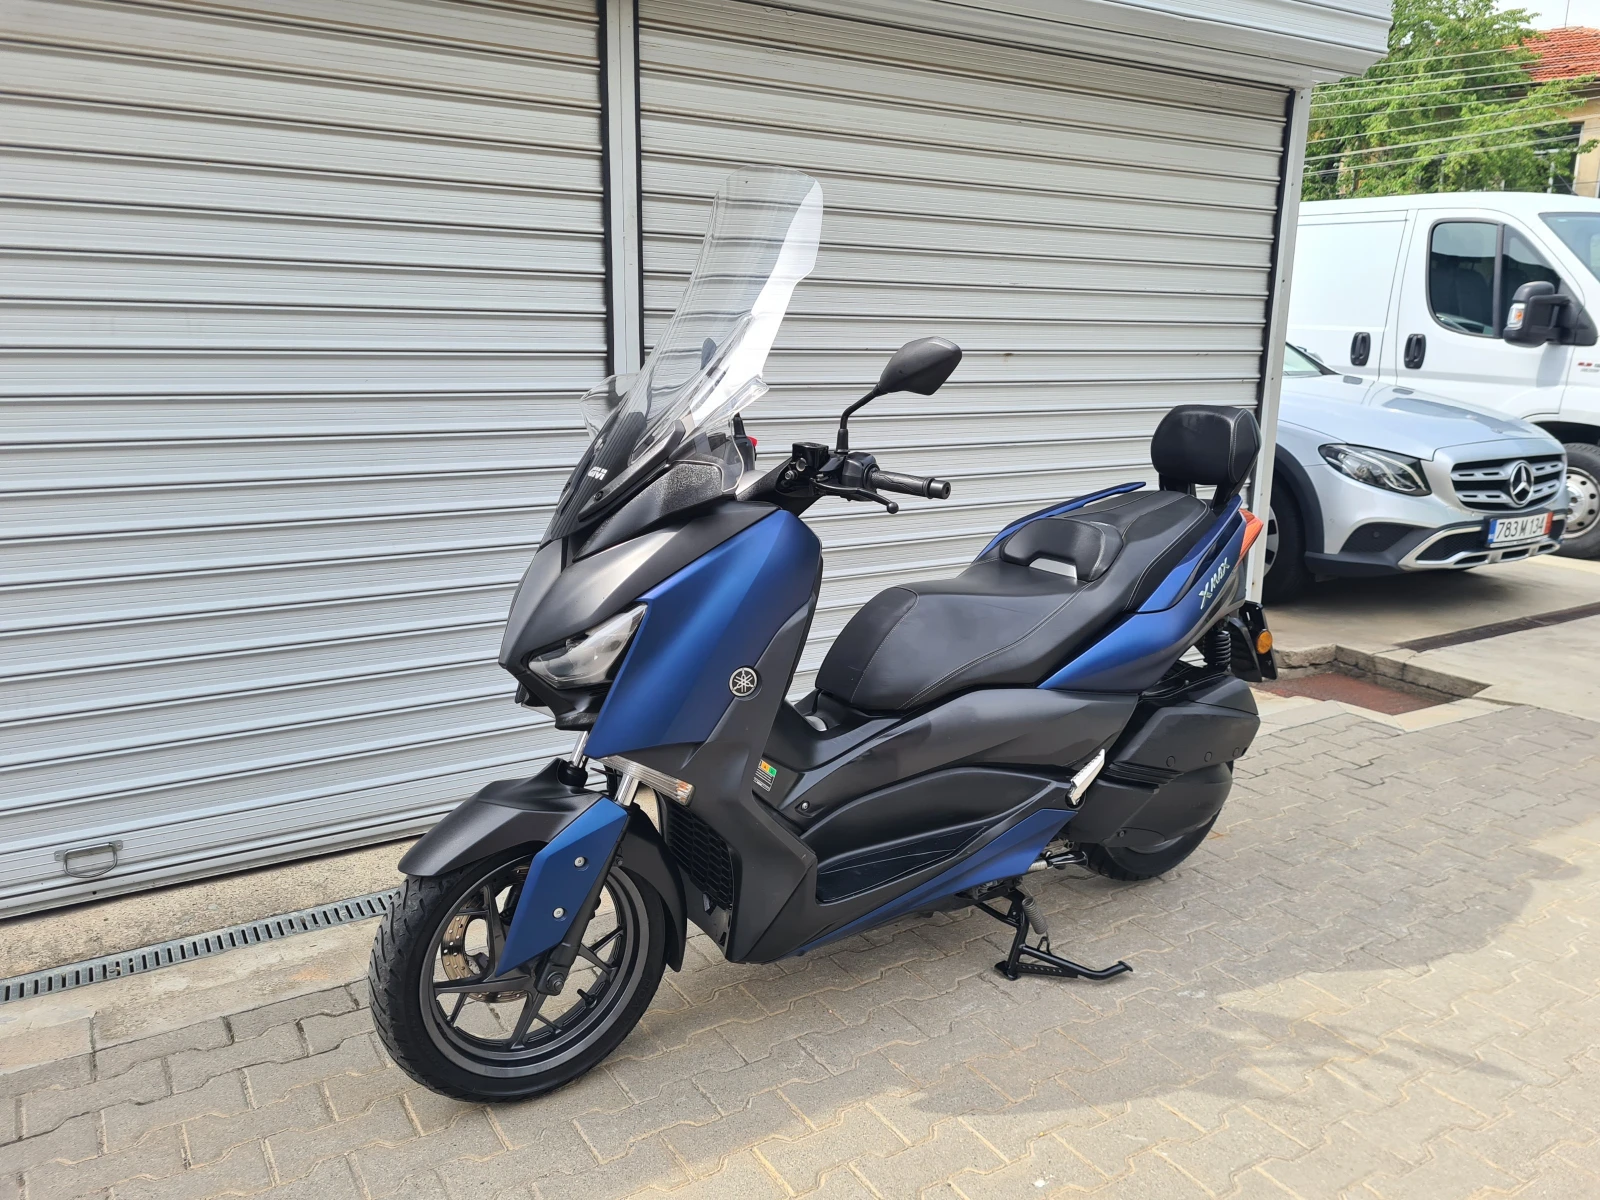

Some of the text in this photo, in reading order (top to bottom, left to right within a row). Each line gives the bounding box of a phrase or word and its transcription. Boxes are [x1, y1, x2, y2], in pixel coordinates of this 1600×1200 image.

[1496, 515, 1546, 539] 783 M 134
